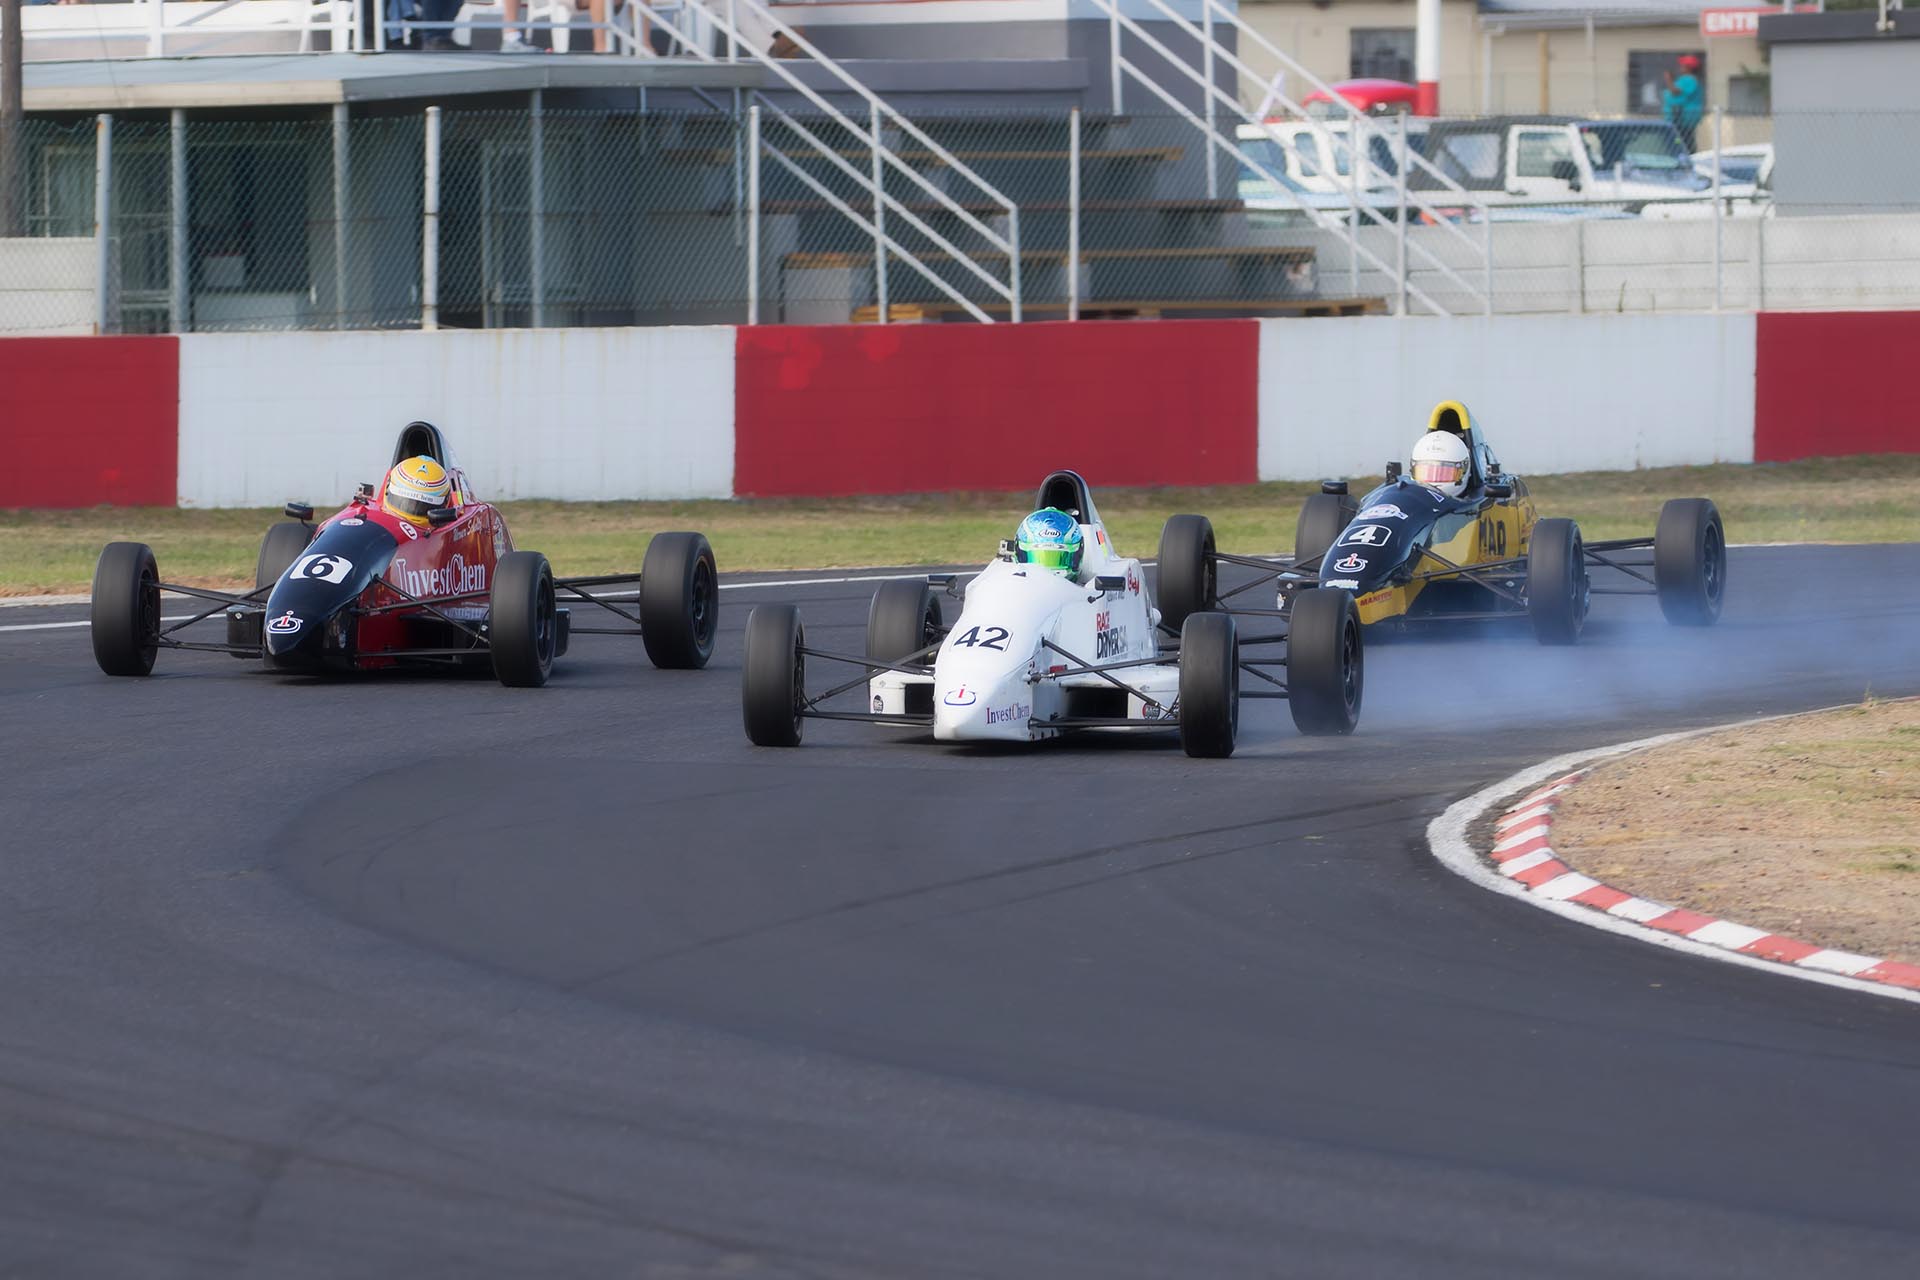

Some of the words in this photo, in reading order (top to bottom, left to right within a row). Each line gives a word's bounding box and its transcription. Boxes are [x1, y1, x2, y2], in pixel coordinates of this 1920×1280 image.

[1349, 526, 1377, 543] 4
[302, 553, 340, 579] 6
[396, 553, 486, 600] InvestChem
[953, 625, 1009, 651] 42
[986, 702, 1030, 724] InvestChem
